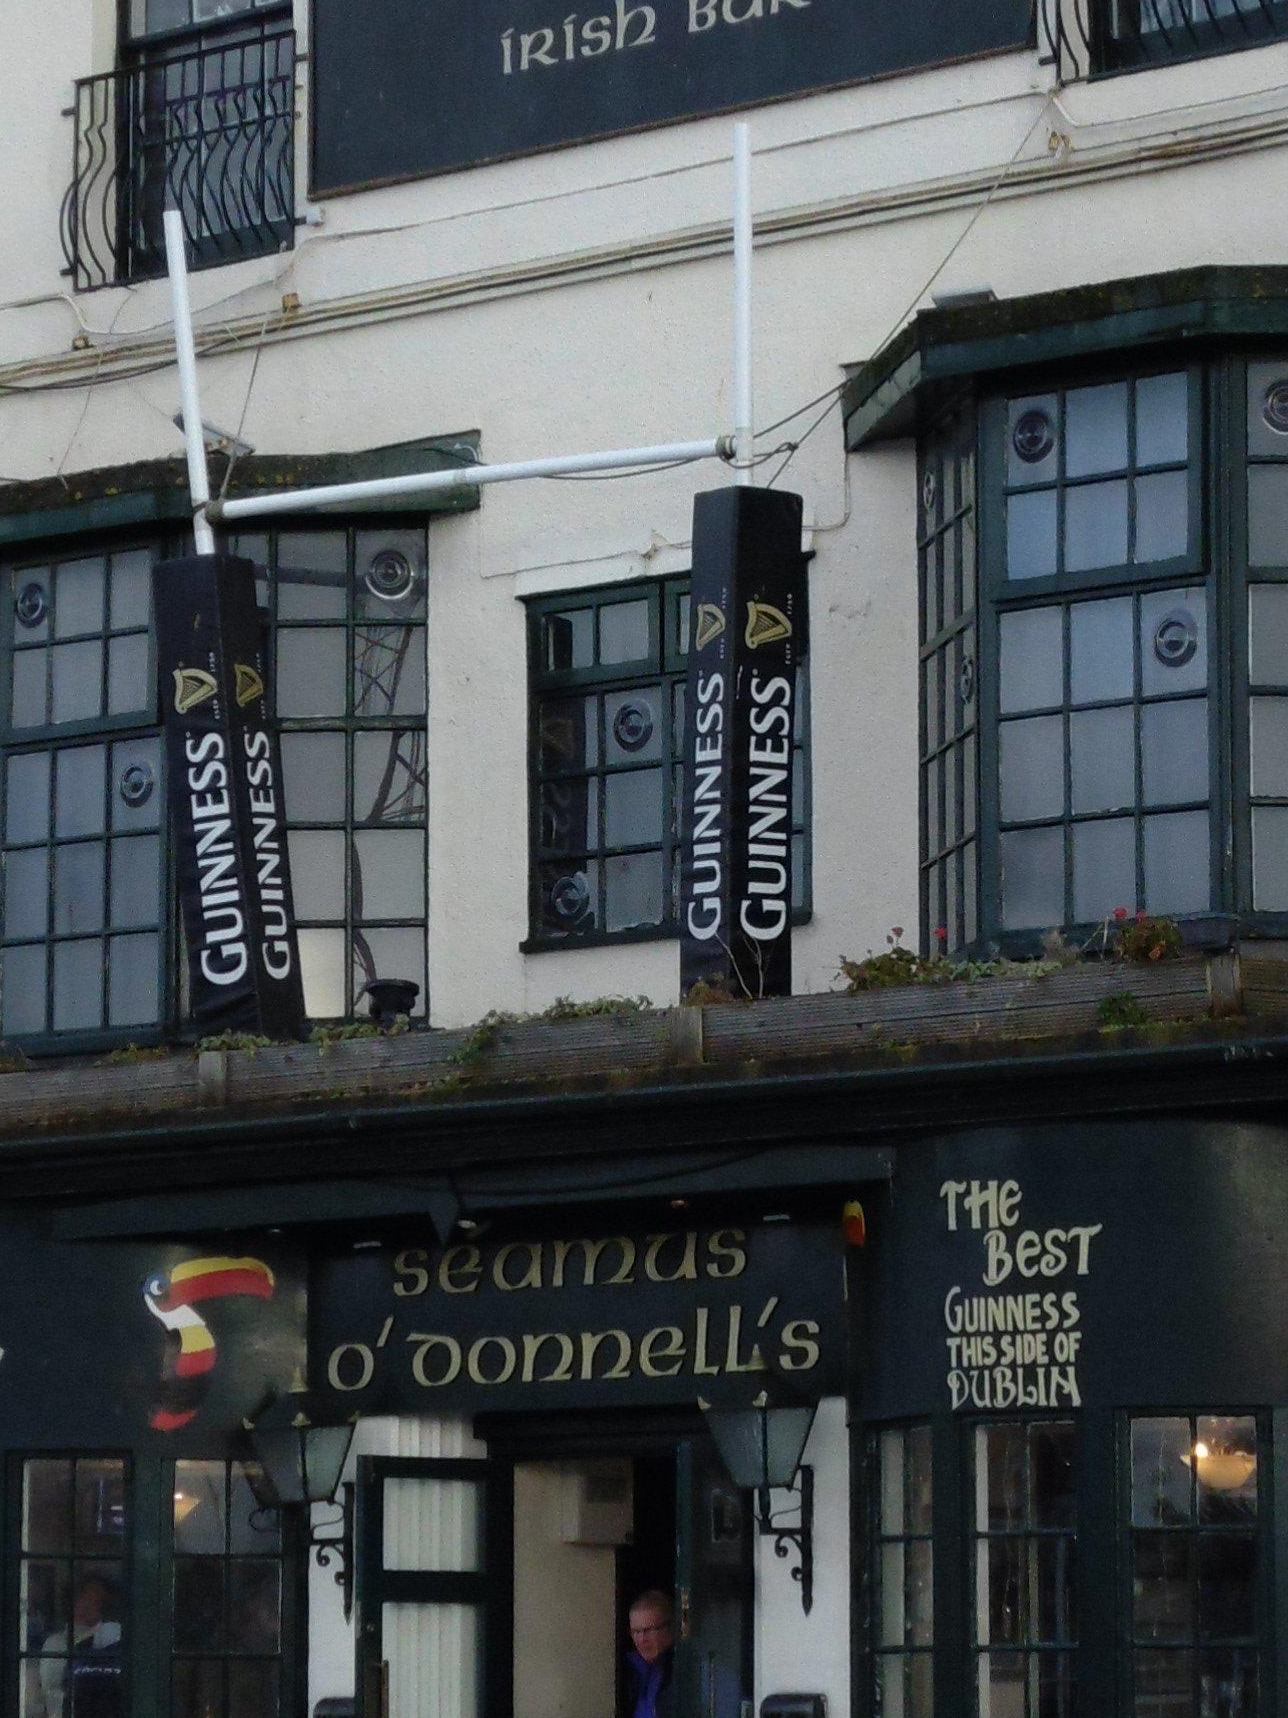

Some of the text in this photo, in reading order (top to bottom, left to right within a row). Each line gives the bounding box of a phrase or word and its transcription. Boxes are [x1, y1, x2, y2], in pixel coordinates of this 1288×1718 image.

[687, 672, 725, 941] GUINNESS
[741, 674, 793, 941] GUINNESS
[186, 732, 249, 985] GUINNESS
[238, 731, 292, 980] GUINNESS
[939, 1180, 1023, 1231] THE
[982, 1223, 1103, 1287] BEST
[944, 1286, 1081, 1333] GUINNESS
[946, 1332, 1083, 1368] THIS SIDE OF
[947, 1366, 1082, 1411] DUBLIN
